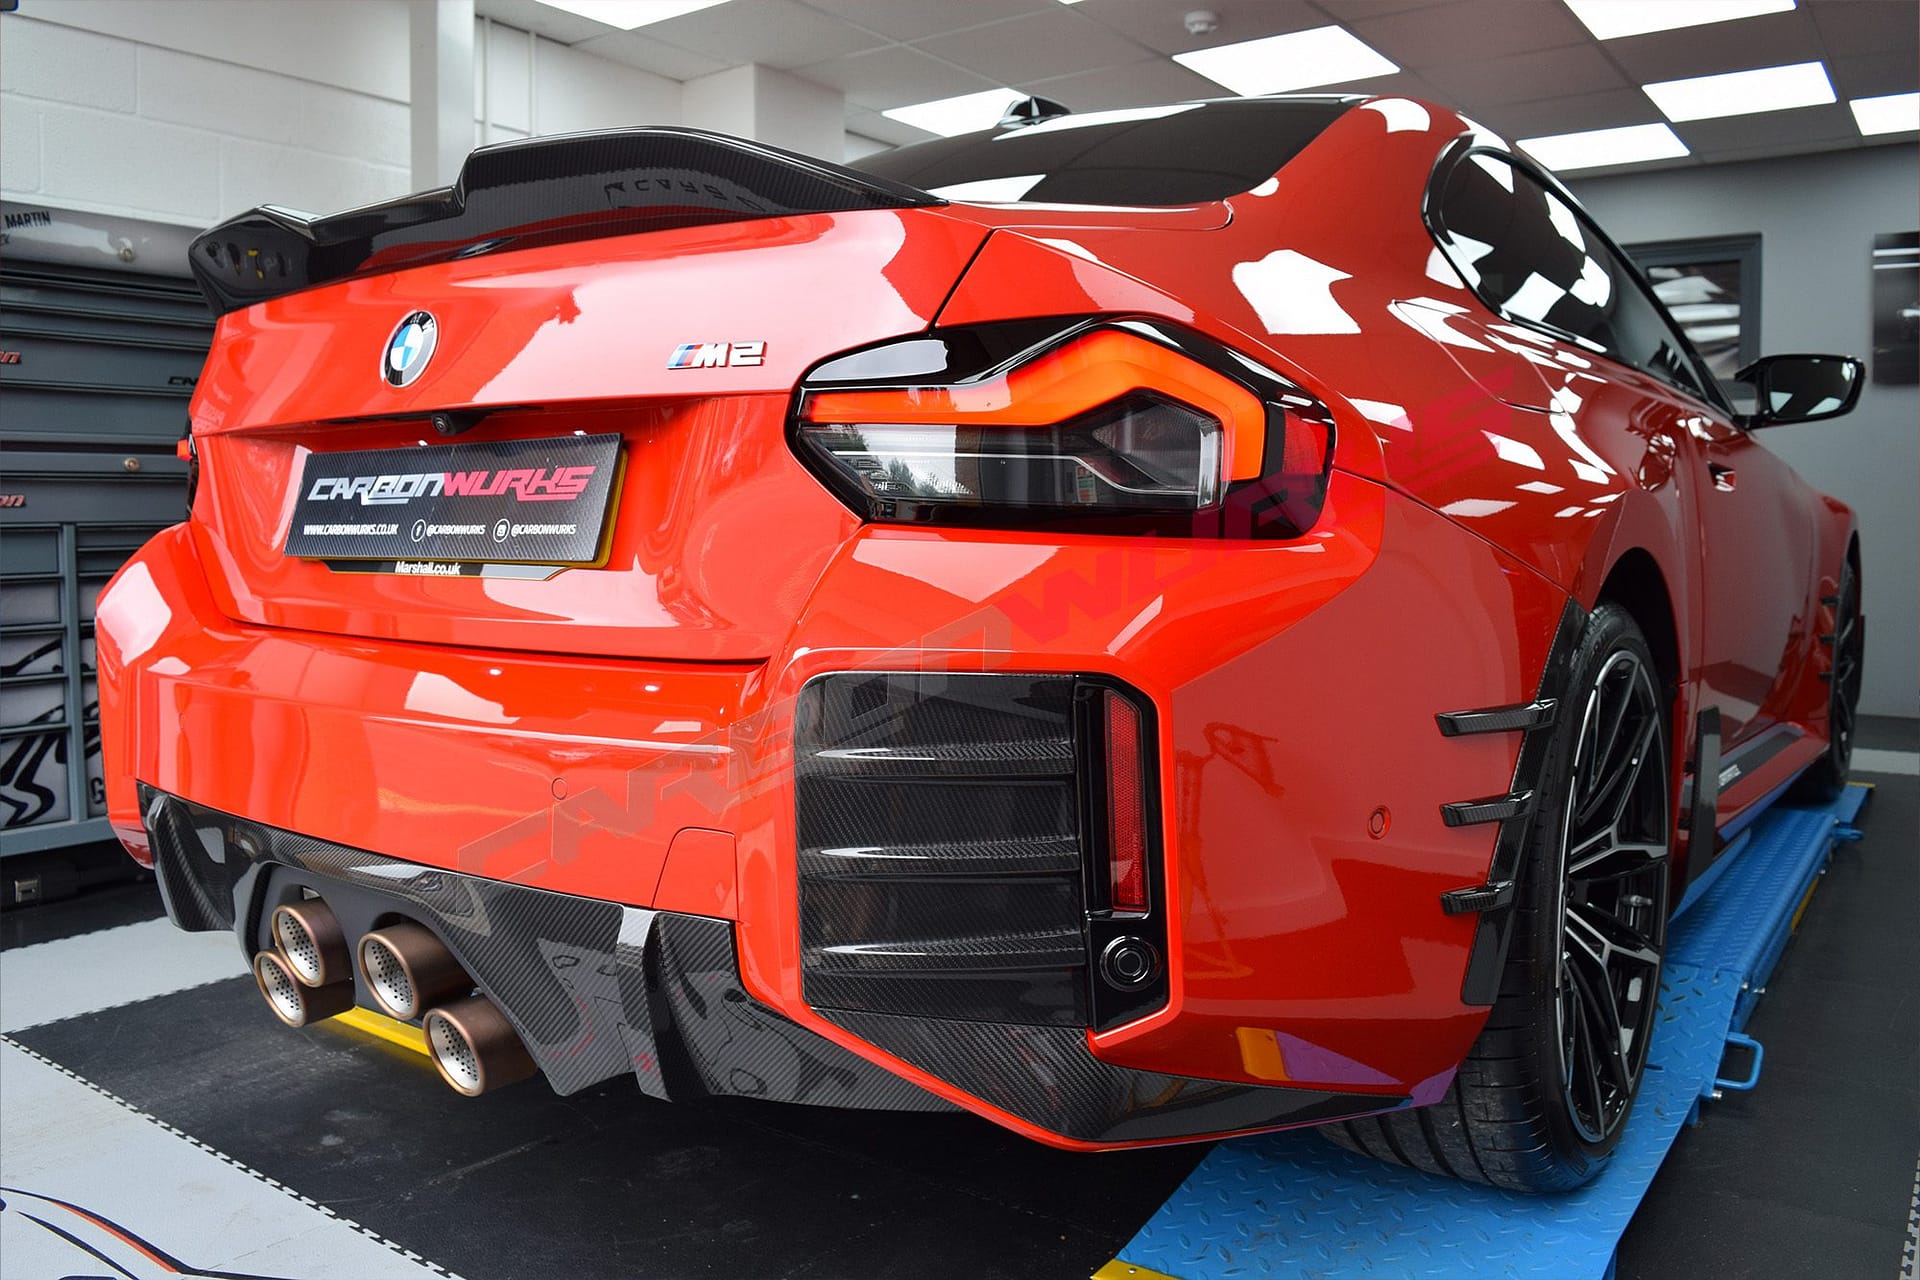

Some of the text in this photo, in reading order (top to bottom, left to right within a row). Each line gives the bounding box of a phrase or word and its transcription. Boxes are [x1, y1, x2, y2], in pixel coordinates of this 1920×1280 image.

[4, 211, 52, 229] MARTIN
[665, 340, 767, 370] M2
[303, 523, 399, 536] WWW.CARBONWURKS.CO.UK
[511, 524, 577, 537] @CARBONWURKS
[395, 561, 461, 576] Marshall.co.uk
